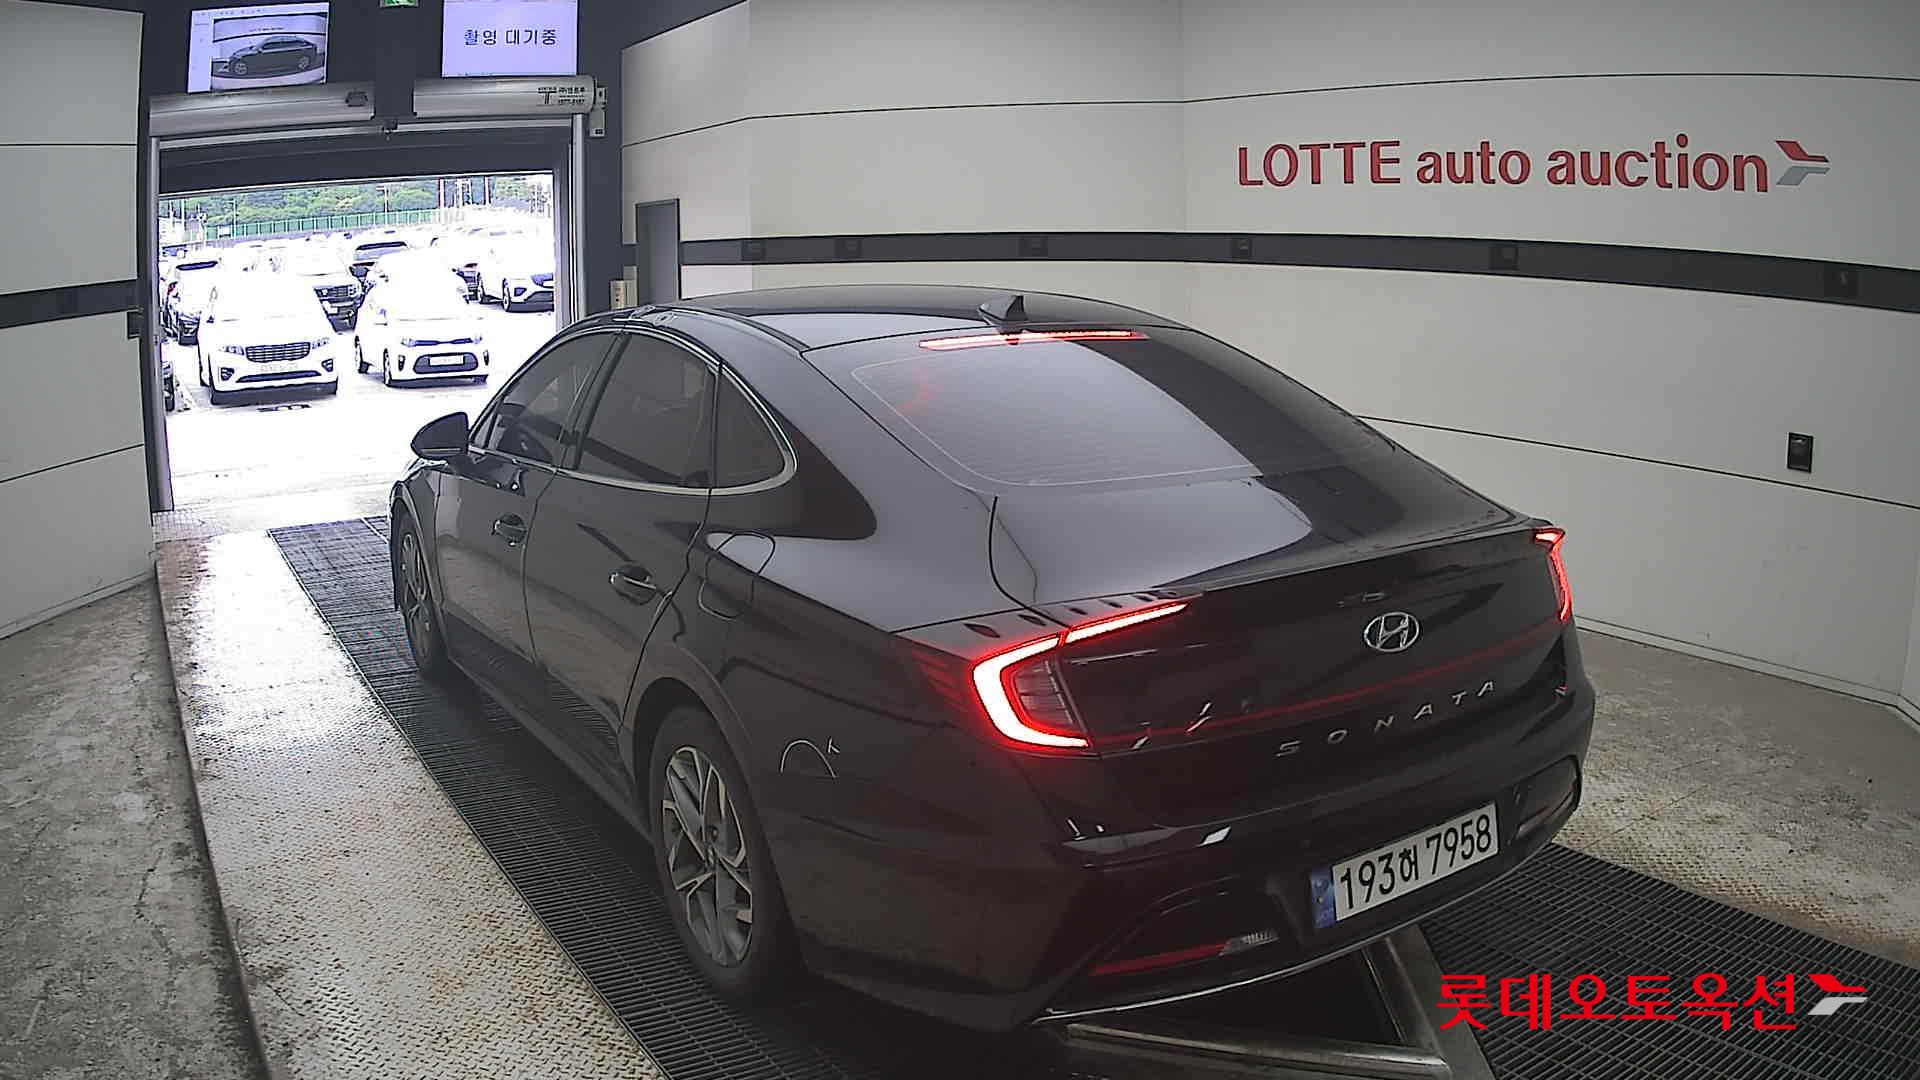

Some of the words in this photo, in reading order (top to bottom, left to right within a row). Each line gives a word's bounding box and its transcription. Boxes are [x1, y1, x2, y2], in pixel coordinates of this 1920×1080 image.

[464, 29, 497, 46] 촬영
[505, 29, 557, 46] 대기중
[1238, 140, 1401, 187] LOTTE
[1416, 141, 1531, 186] auto
[1547, 133, 1769, 193] auction
[1275, 681, 1494, 757] SONATA
[1340, 842, 1420, 910] 193허
[1426, 813, 1493, 876] 7958
